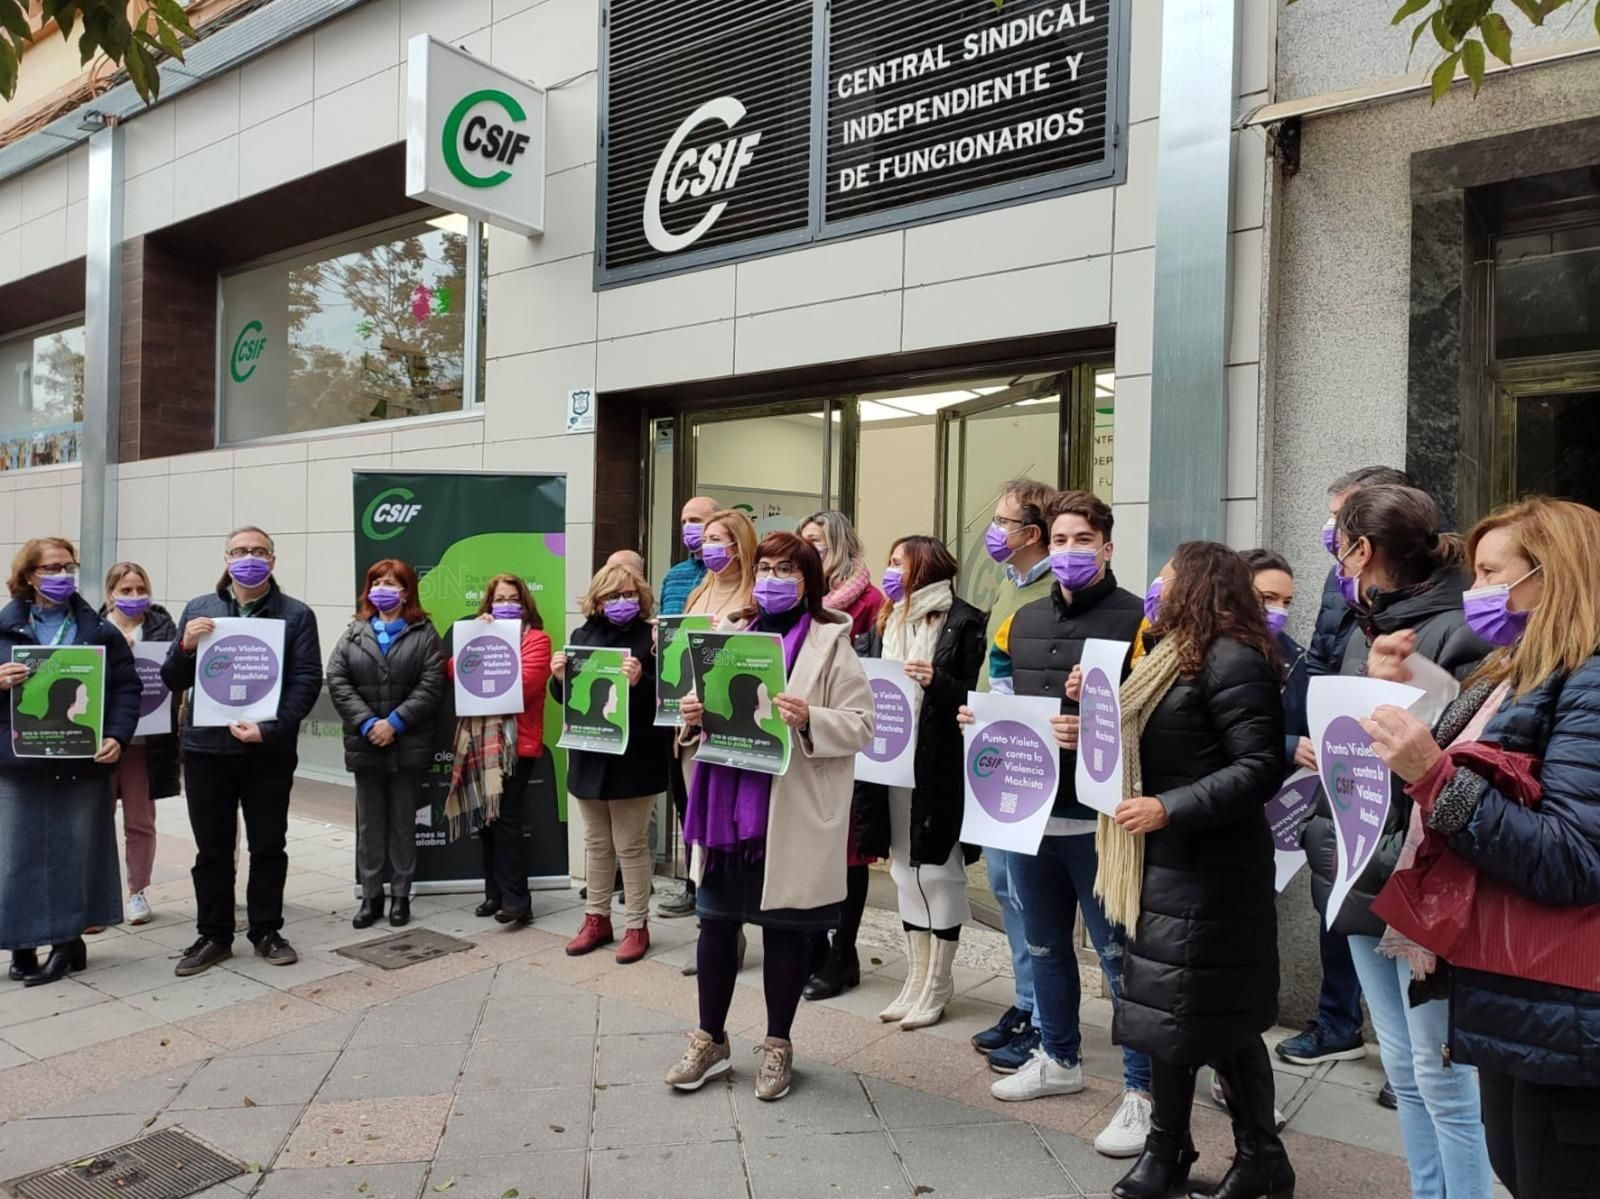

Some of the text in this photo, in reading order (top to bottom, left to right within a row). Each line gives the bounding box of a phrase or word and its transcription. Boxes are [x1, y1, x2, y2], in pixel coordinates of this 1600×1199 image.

[837, 0, 1095, 99] CENTRAL SINDICAL
[843, 52, 1083, 144] INDEPENDIENTE Y
[463, 115, 531, 166] CSIF
[840, 107, 1085, 192] DE FUNCIONARIOS
[666, 132, 762, 203] CSIF
[238, 338, 267, 362] CSIF
[373, 503, 422, 523] CSIF
[214, 645, 237, 653] Punto
[702, 647, 738, 665] 25N
[879, 691, 902, 700] Violeta
[876, 712, 904, 722] Violencia
[876, 723, 904, 734] Machista
[982, 732, 1040, 748] Punto Violeta
[1005, 751, 1043, 762] contra la
[1325, 741, 1349, 756] Punto
[979, 756, 1003, 769] CSIF
[1004, 762, 1044, 776] Violencia
[1353, 765, 1384, 781] contra la
[1004, 776, 1043, 790] Machista
[1336, 777, 1354, 795] CSIF
